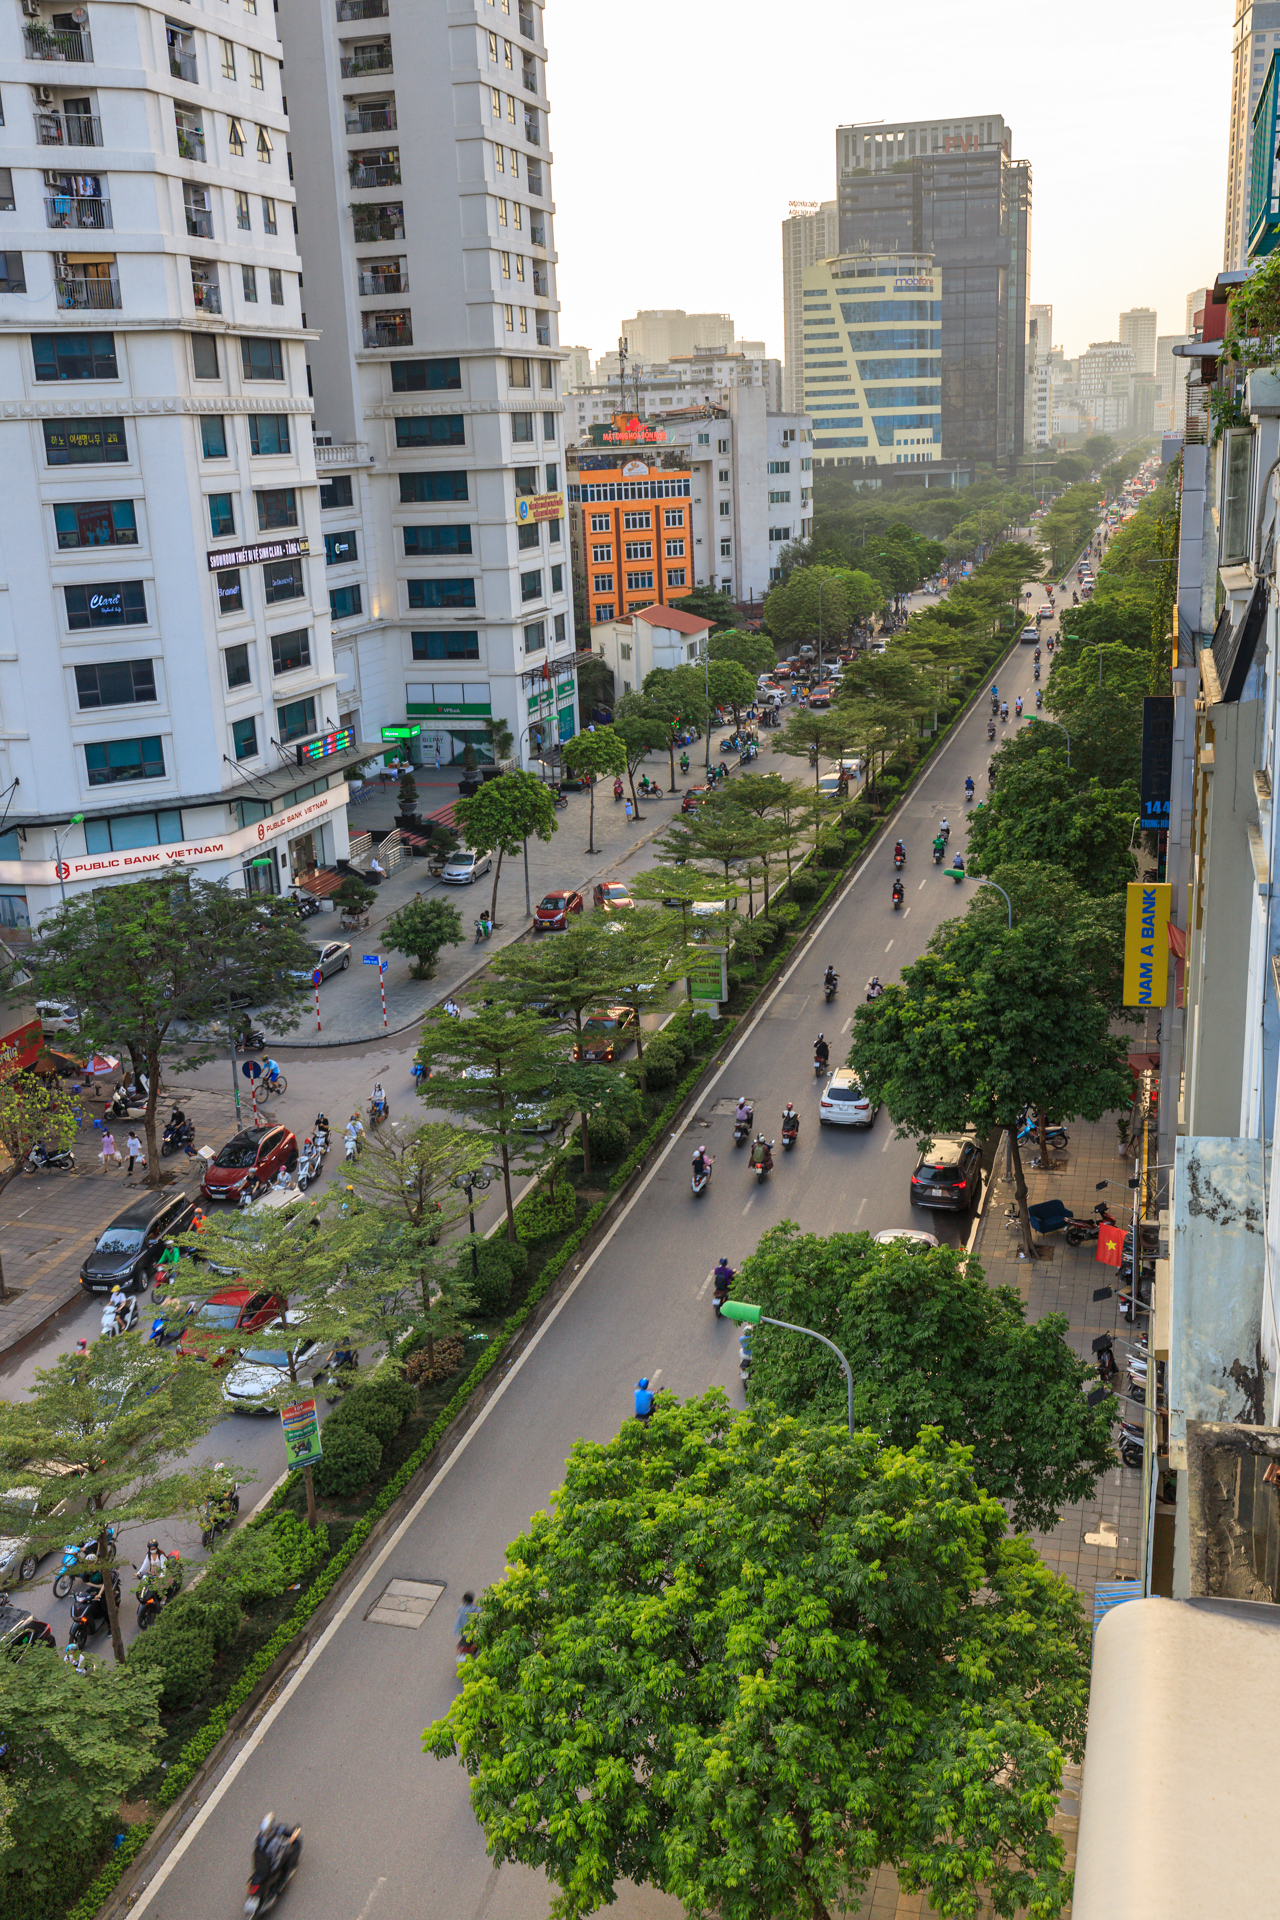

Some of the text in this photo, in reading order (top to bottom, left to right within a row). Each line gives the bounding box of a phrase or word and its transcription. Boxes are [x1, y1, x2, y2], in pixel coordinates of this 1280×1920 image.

[945, 135, 979, 153] PVI
[895, 275, 934, 286] mobifone
[615, 432, 628, 441] ONG
[628, 431, 641, 440] HOA
[269, 545, 283, 558] CLARA
[90, 594, 119, 609] Clara
[1145, 800, 1170, 814] 144
[266, 798, 328, 832] PUBLIC BANK VIETNAM
[1141, 819, 1160, 828] TRUNG
[75, 844, 223, 873] PUBLIC BANK VIETNAM
[1138, 887, 1157, 1005] NAM A BANK
